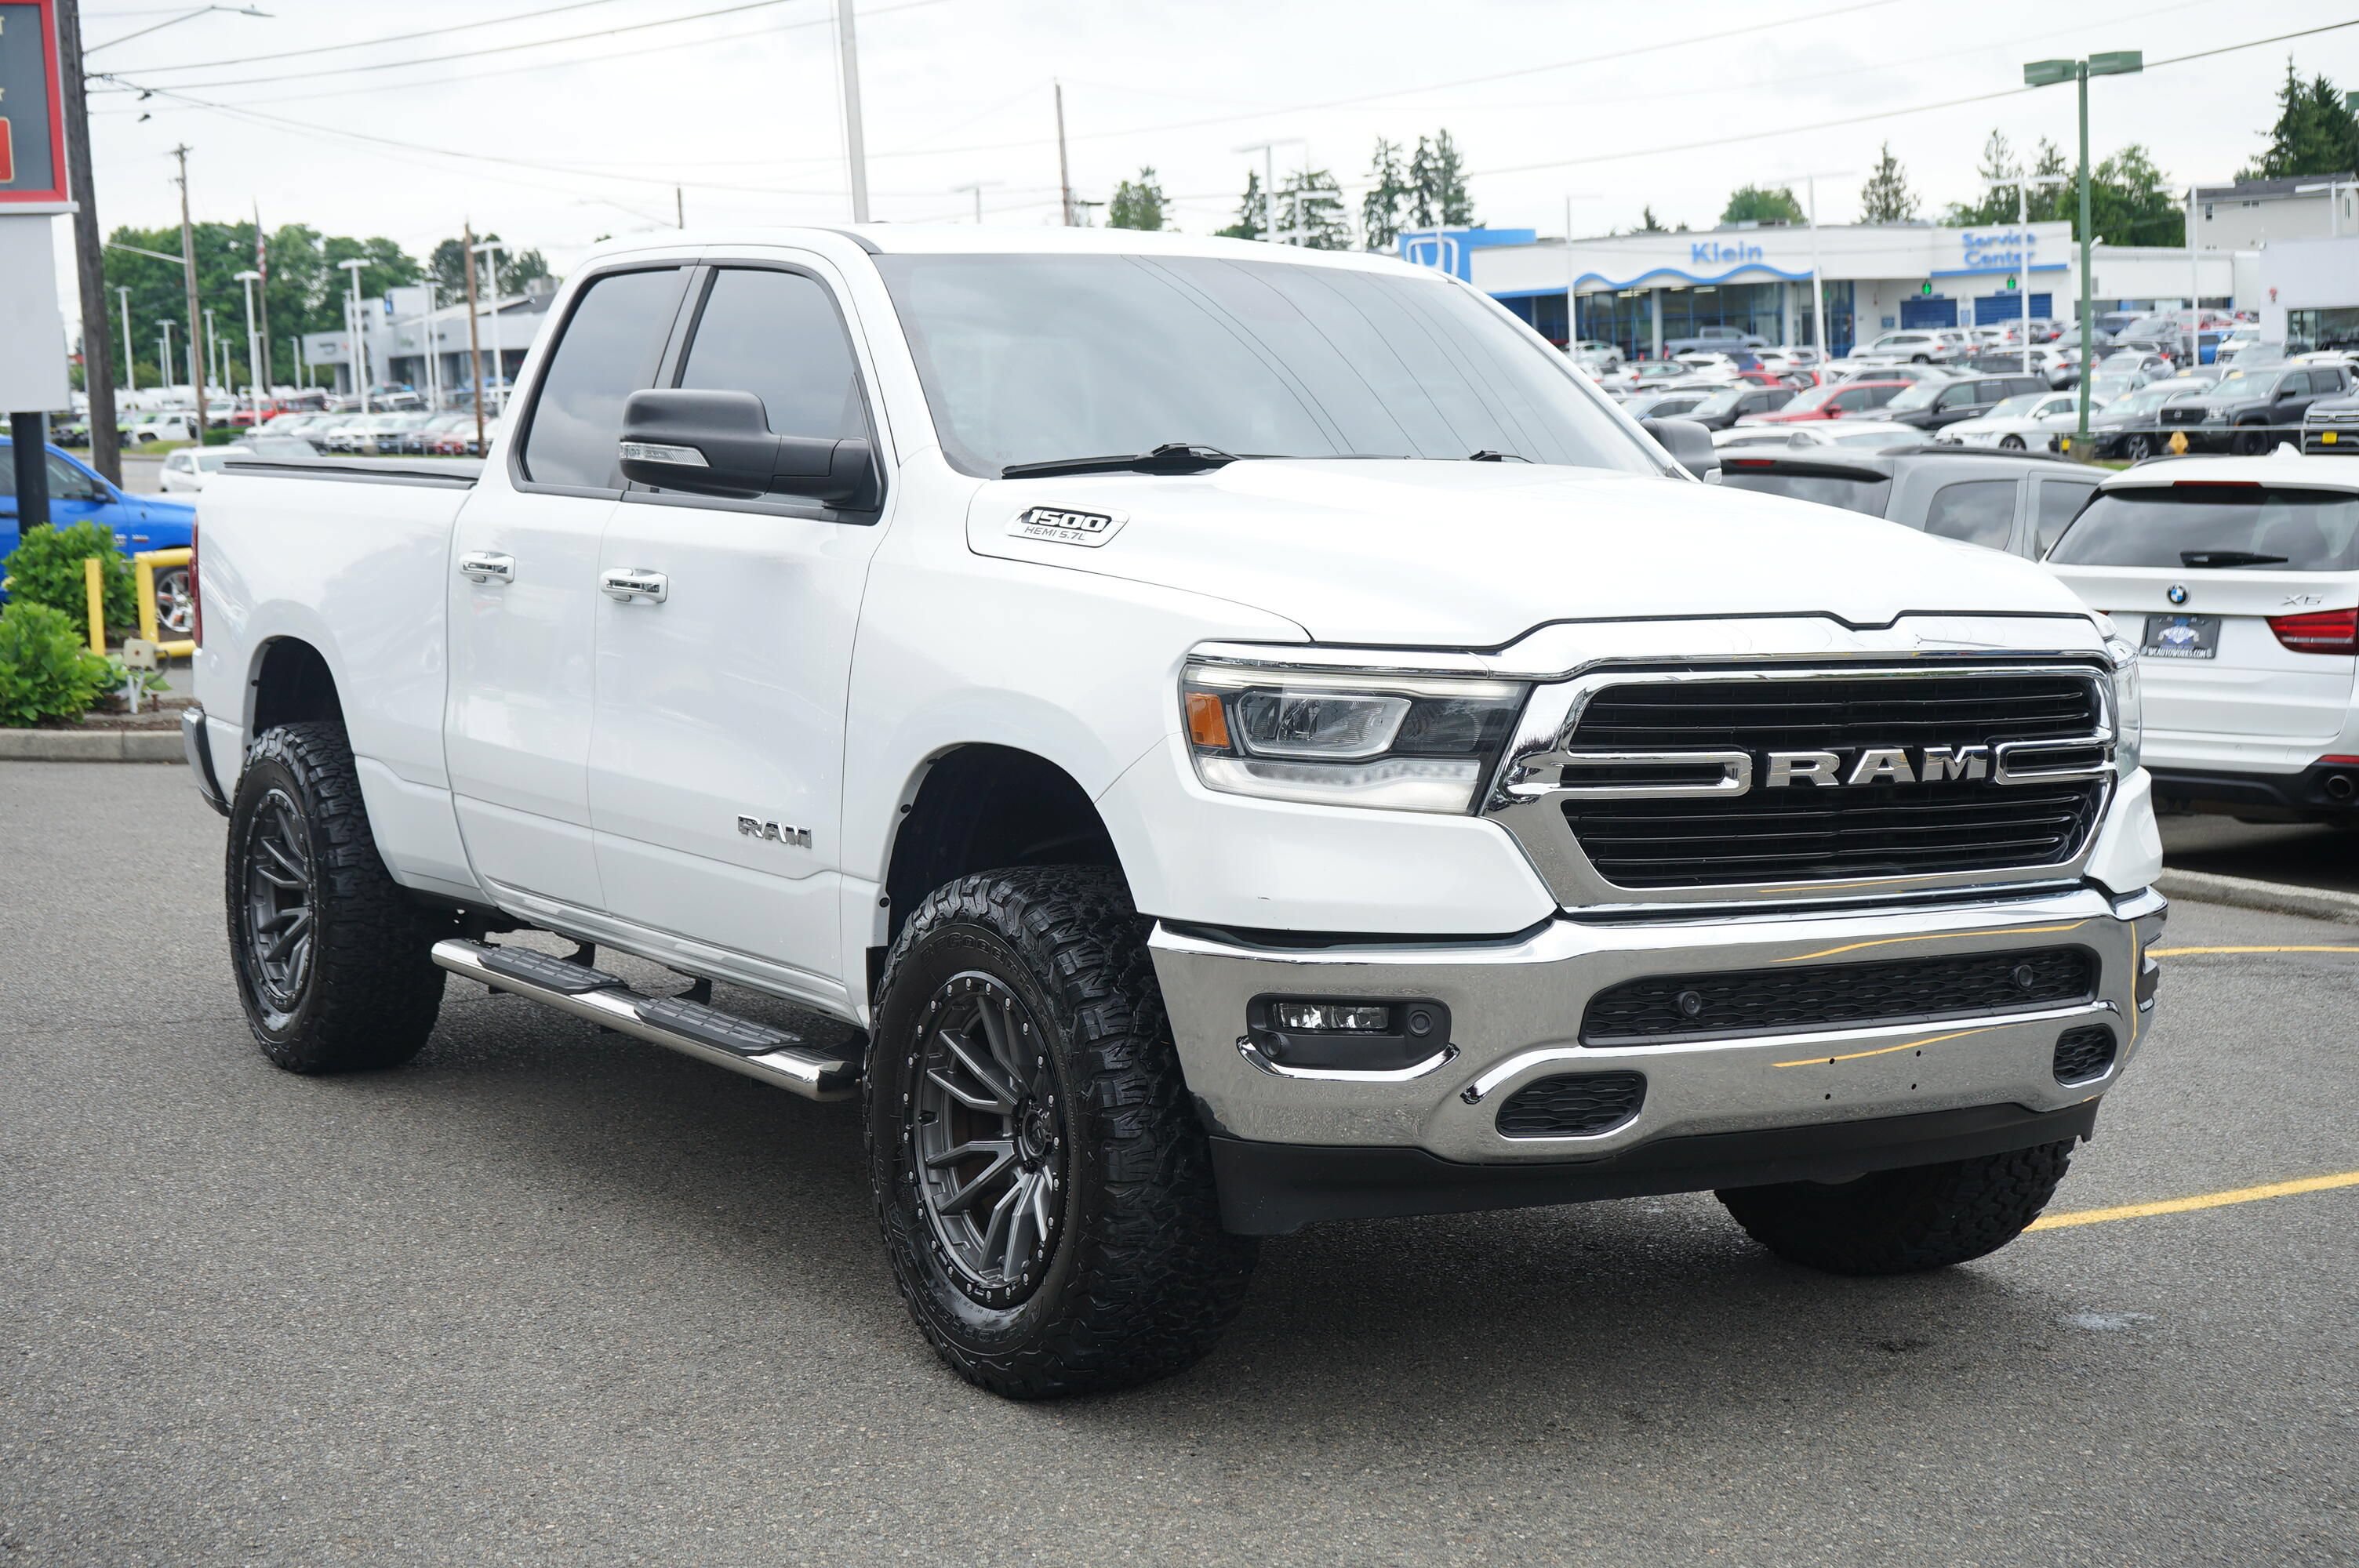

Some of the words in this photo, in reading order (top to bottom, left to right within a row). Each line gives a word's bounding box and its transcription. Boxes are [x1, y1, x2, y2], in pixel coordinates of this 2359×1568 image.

[1963, 230, 2036, 248] Service
[1691, 241, 1762, 263] Klein
[1964, 250, 2036, 267] Center
[1027, 508, 1111, 532] 1500
[1024, 526, 1056, 537] HEMI
[1059, 530, 1086, 541] 5.7L
[1765, 744, 1989, 788] RAM
[737, 813, 812, 849] RAM
